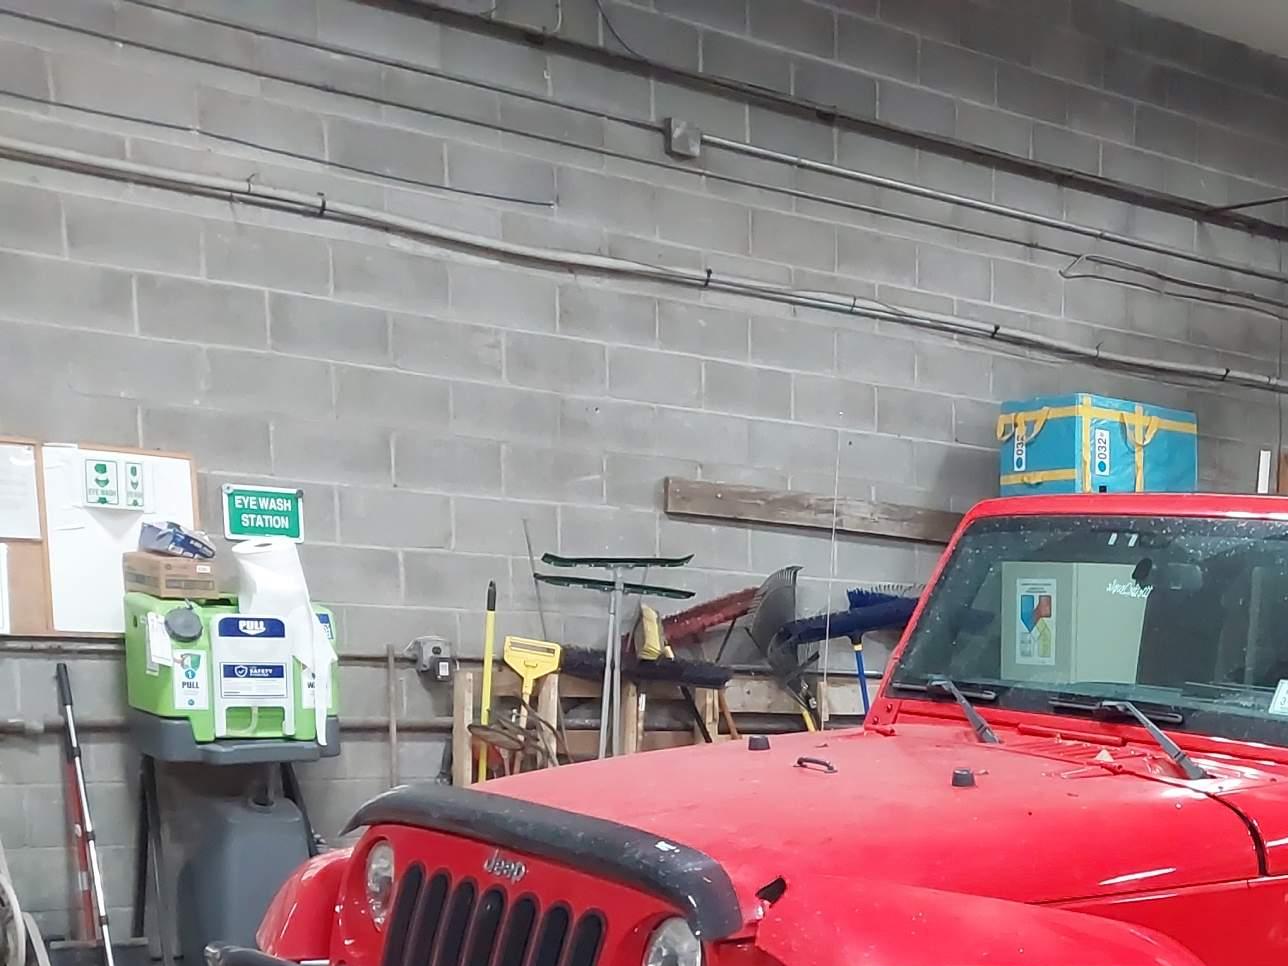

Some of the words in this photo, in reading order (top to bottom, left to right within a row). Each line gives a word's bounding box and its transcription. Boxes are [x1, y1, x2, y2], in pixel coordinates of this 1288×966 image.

[1097, 438, 1107, 460] 032
[235, 496, 257, 510] EYE
[258, 498, 292, 511] WASH
[241, 514, 289, 529] STATION
[239, 620, 265, 630] PULL
[182, 681, 200, 689] PULL
[484, 848, 526, 884] Jeep
